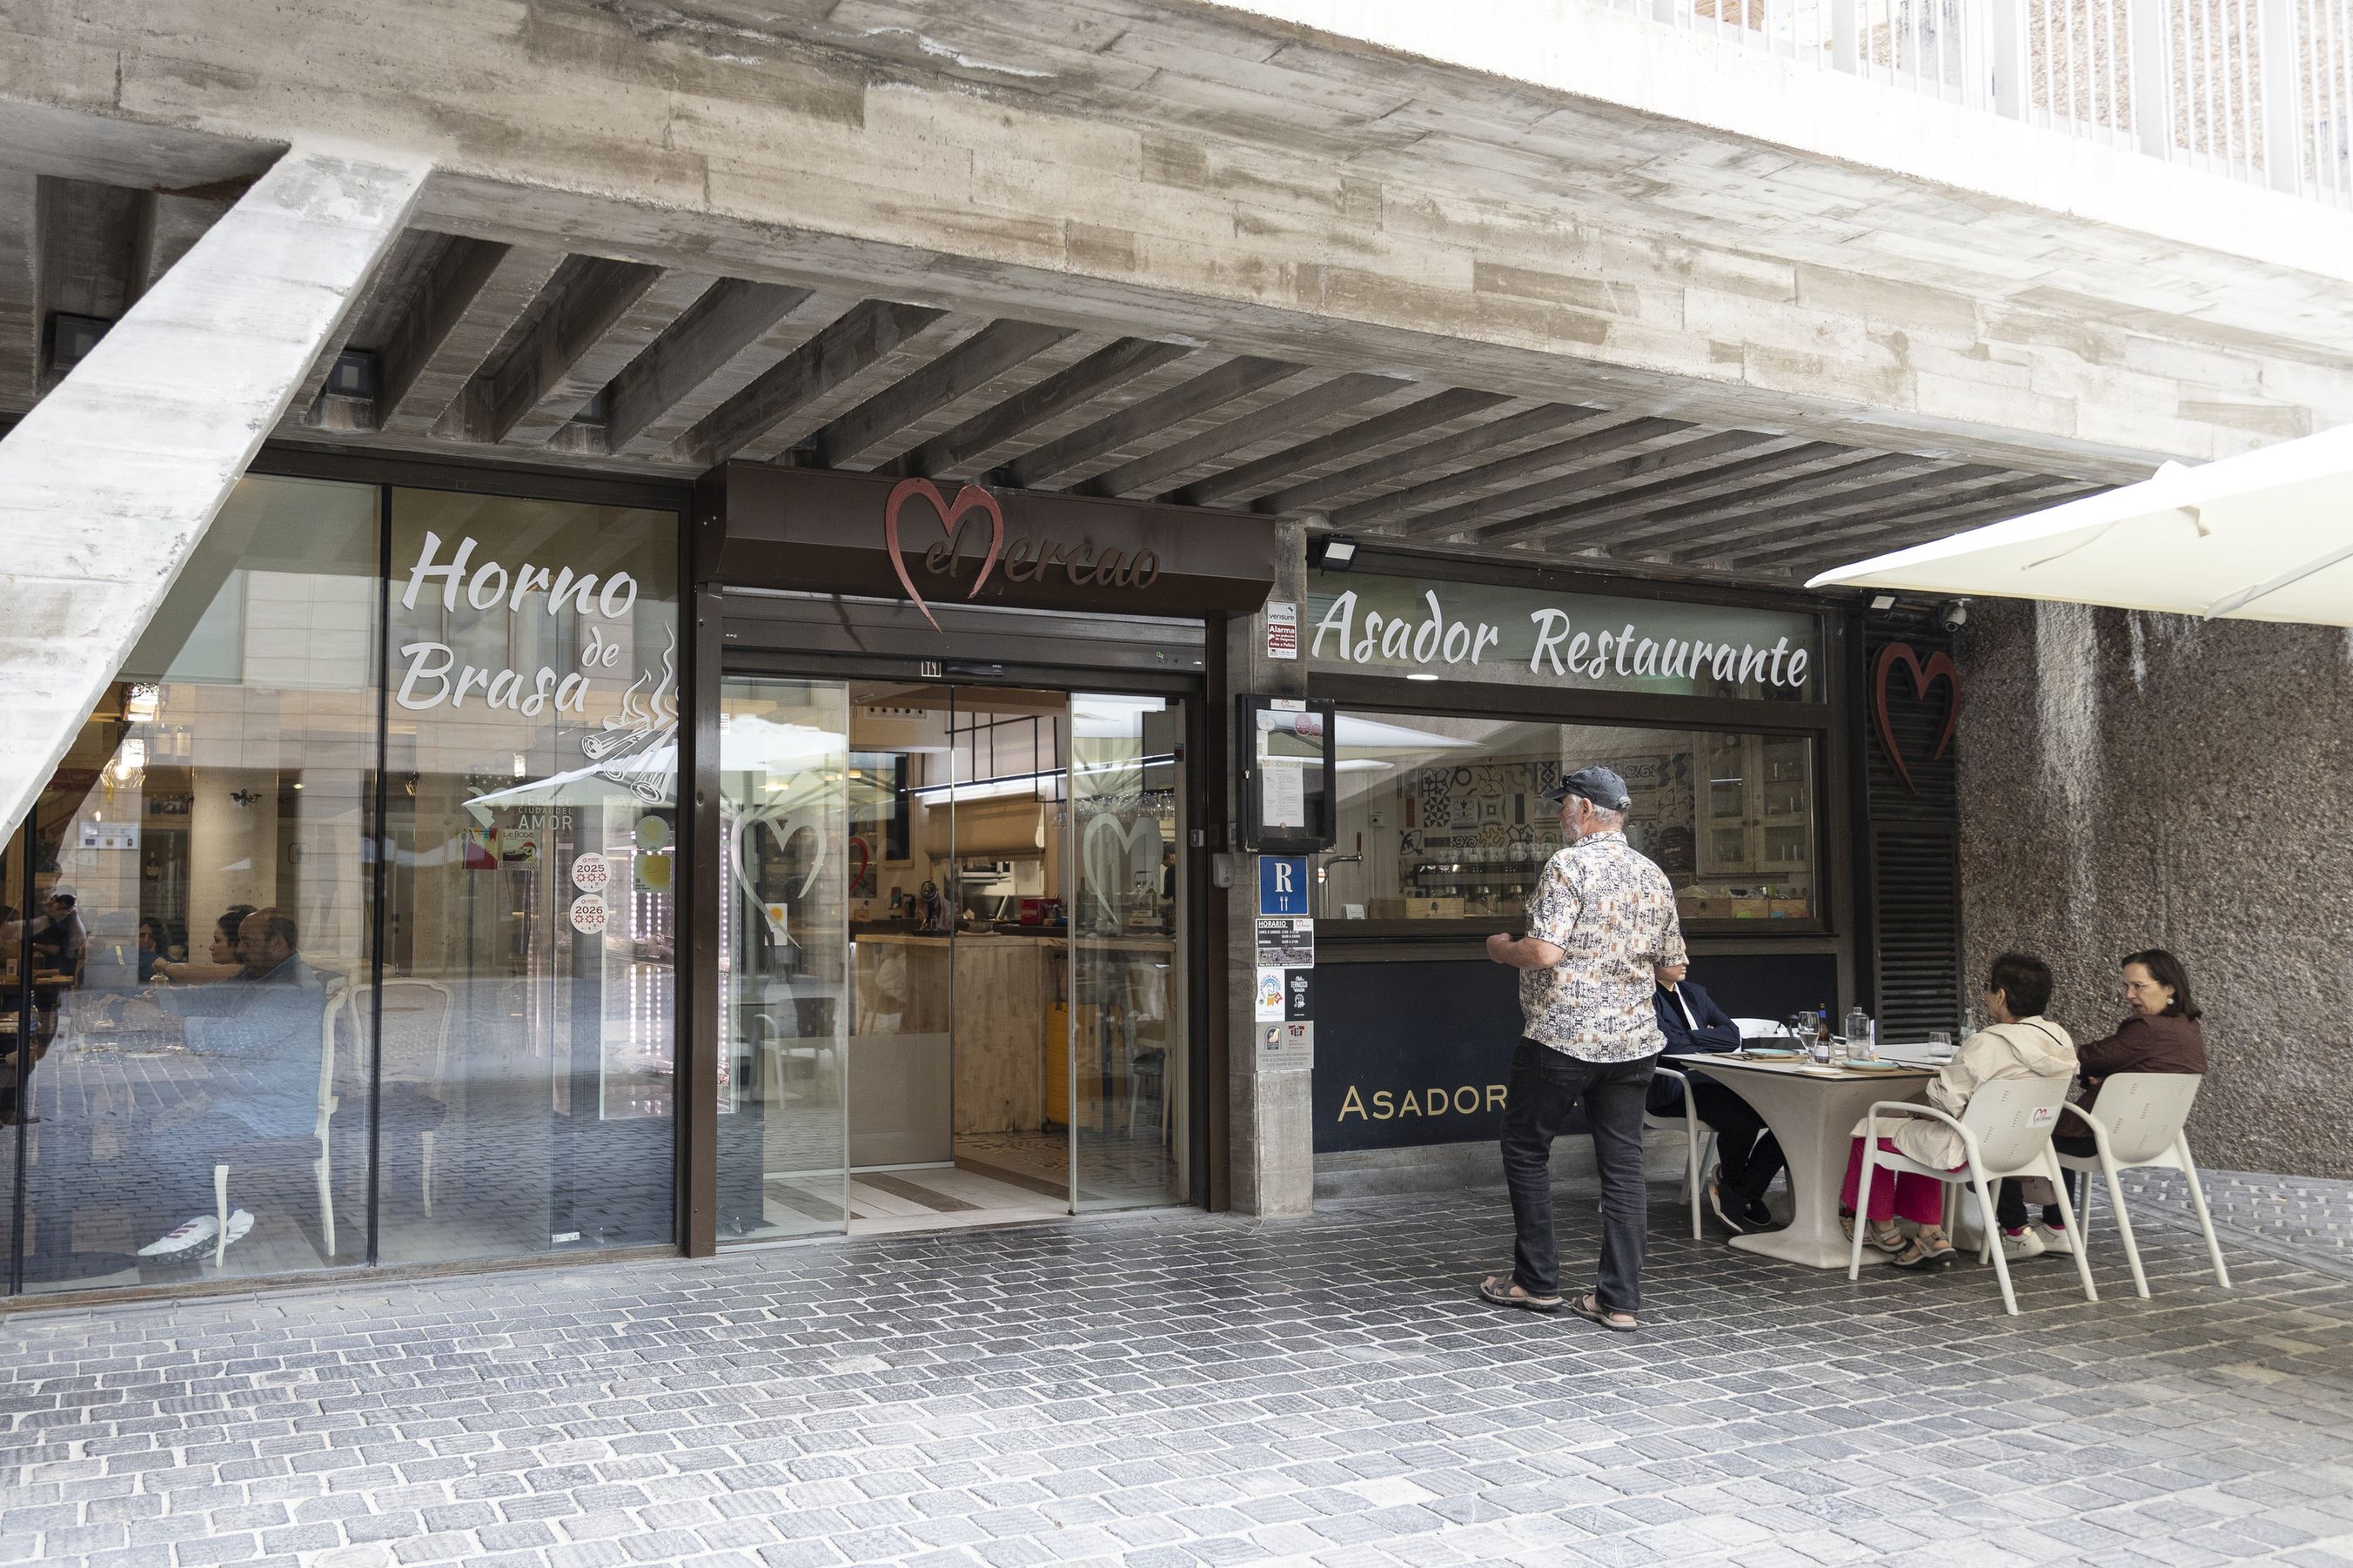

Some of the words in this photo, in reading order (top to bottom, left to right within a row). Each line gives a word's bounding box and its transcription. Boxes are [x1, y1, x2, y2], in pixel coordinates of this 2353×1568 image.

[401, 530, 638, 619] Horno
[581, 626, 620, 667] de
[1269, 626, 1295, 634] Alarma
[1311, 589, 1498, 666] Asador
[1530, 608, 1808, 687] Restaurante
[396, 641, 591, 717] Brasa
[518, 814, 573, 830] AMOR
[576, 864, 605, 873] 2025
[1274, 861, 1293, 893] R
[575, 906, 603, 915] 2026
[1337, 1084, 1508, 1122] ASADOR
